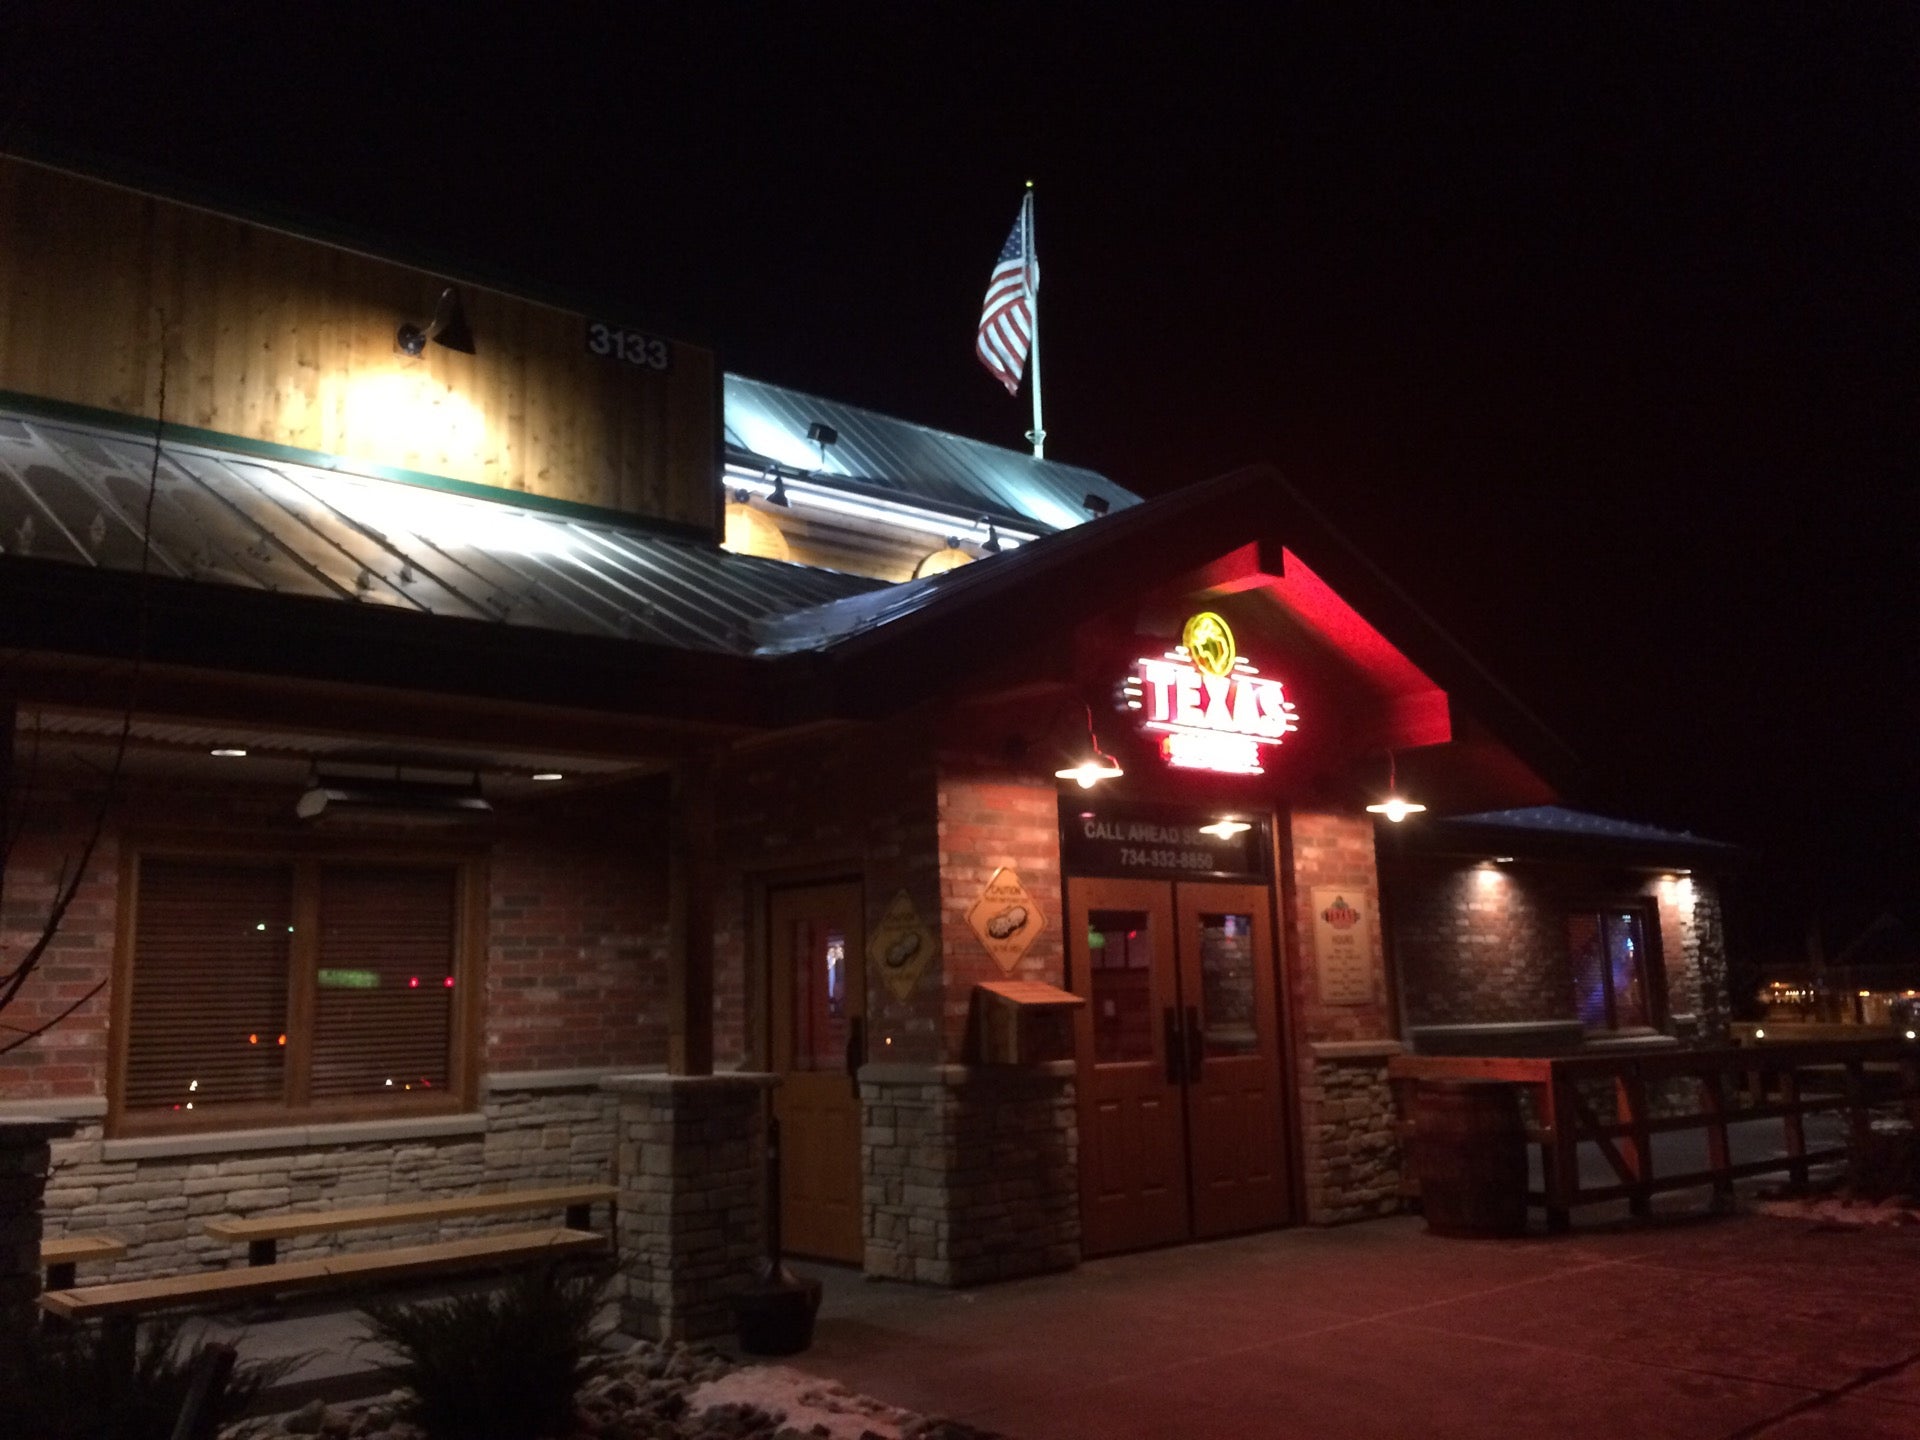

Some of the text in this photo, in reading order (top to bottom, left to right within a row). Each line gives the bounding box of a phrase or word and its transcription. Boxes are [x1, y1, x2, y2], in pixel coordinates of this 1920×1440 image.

[589, 323, 668, 370] 3133
[1143, 663, 1287, 739] TEXAS
[1083, 820, 1125, 841] CALL
[1127, 823, 1179, 844] AHEAD
